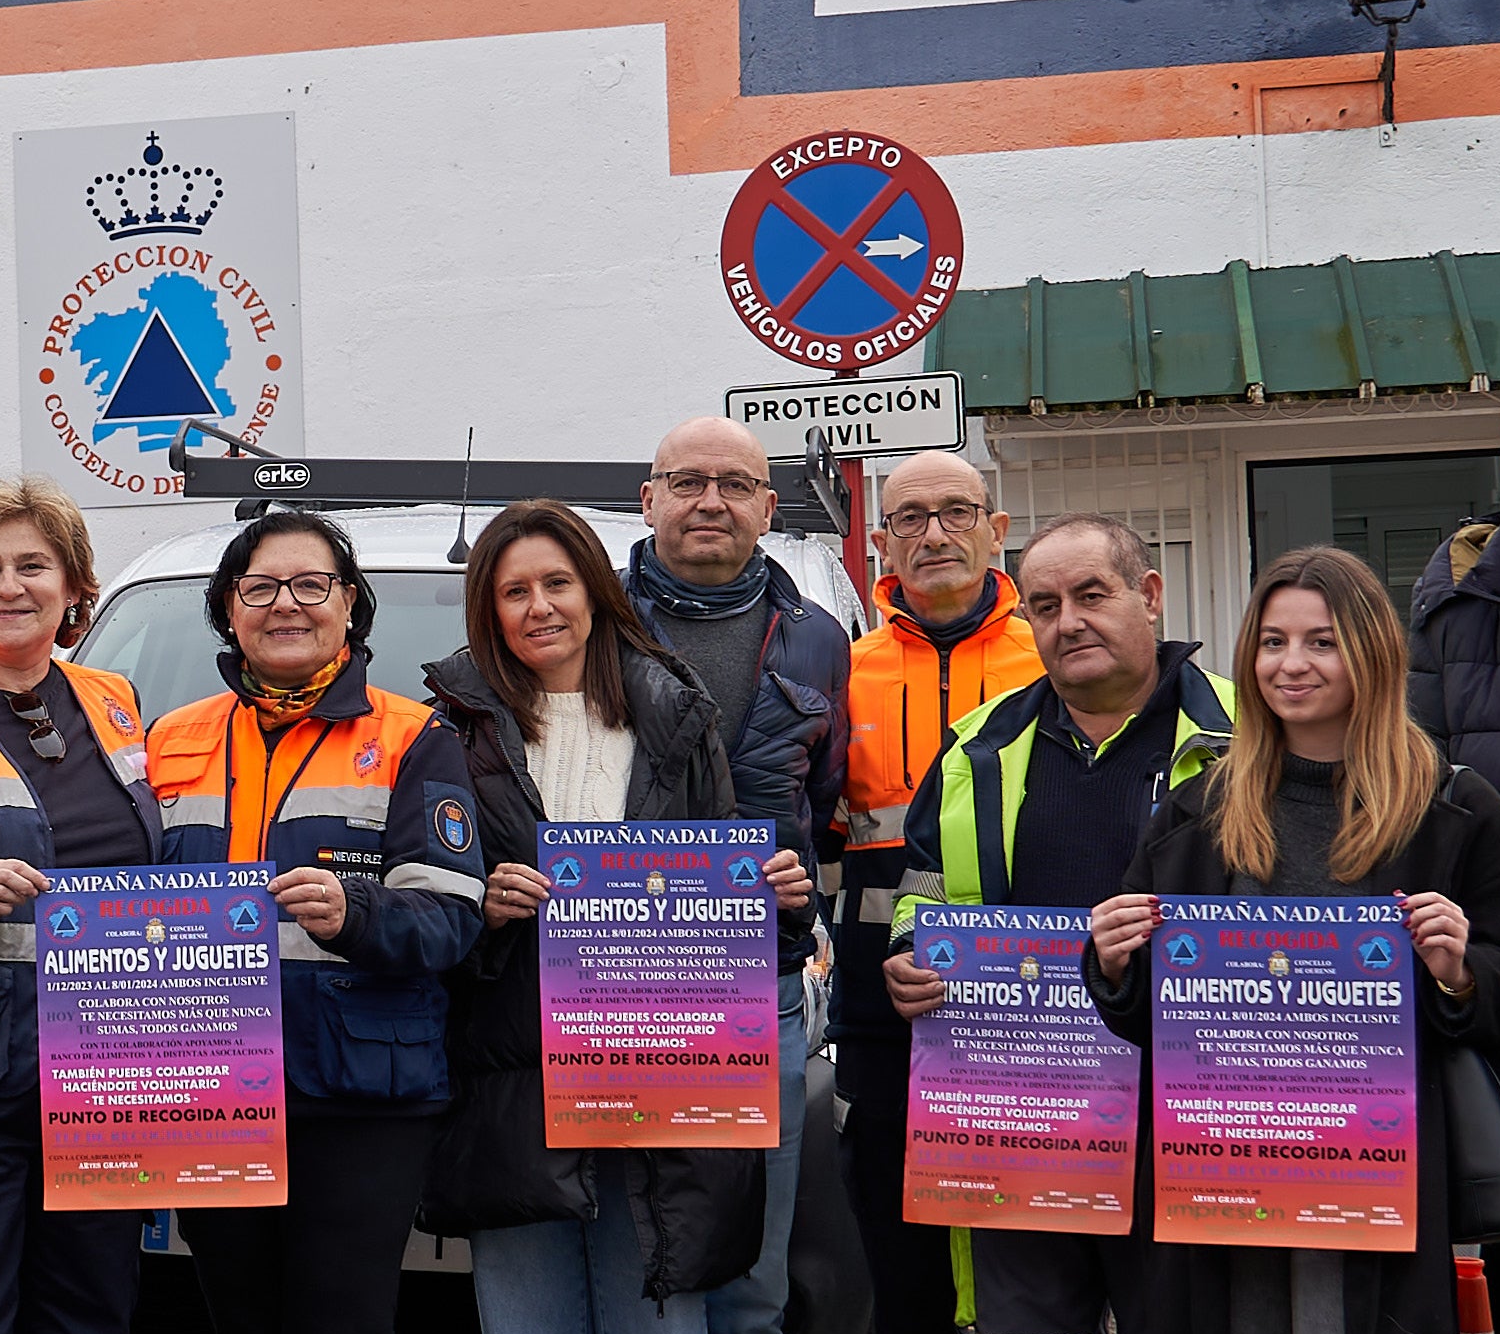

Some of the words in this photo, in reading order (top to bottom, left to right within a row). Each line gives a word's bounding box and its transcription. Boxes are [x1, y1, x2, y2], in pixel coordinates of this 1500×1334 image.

[771, 137, 902, 180] EXCEPTO
[42, 245, 213, 356] PROTECCION
[218, 267, 275, 343] CIVIL
[727, 263, 842, 364] VEHÍCULOS
[854, 255, 956, 361] OFICIALES
[743, 385, 941, 423] PROTECCIÓN
[45, 394, 145, 493] CONCELLO
[154, 476, 185, 495] DE
[257, 464, 307, 483] erke
[543, 825, 646, 844] CAMPAÑA
[651, 828, 723, 844] NADAL
[728, 827, 768, 844] 2023
[333, 851, 361, 863] NIEVES
[363, 853, 382, 865] GLEZ
[600, 852, 711, 869] RECOGIDA
[44, 871, 144, 893] CAMPAÑA
[149, 871, 222, 890] NADAL
[227, 869, 269, 887] 2023
[99, 897, 211, 917] RECOGIDA
[546, 898, 649, 921] ALIMENTOS
[654, 898, 667, 921] Y
[672, 898, 766, 921] JUGUETES
[1158, 901, 1267, 921] CAMPAÑA
[1272, 905, 1351, 922] NADAL
[1357, 905, 1402, 923] 2023
[920, 909, 1022, 929] CAMPAÑA
[976, 936, 1083, 956] RECOGIDA
[1218, 929, 1339, 949] RECOGIDA
[44, 947, 149, 974] ALIMENTOS
[154, 946, 168, 971] Y
[172, 944, 268, 971] JUGUETES
[47, 980, 92, 991] 1/12/2023
[93, 980, 110, 990] AL
[111, 979, 157, 989] 8/01/2024
[159, 977, 201, 988] AMBOS
[204, 975, 267, 987] INCLUSIVE
[1160, 977, 1272, 1004] ALIMENTOS
[1277, 979, 1292, 1004] Y
[1297, 980, 1401, 1006] JUGUETES
[78, 997, 140, 1008] COLABORA
[142, 996, 167, 1007] CON
[168, 994, 229, 1006] NOSOTROS
[943, 978, 1022, 1006] IMENTOS
[1026, 983, 1040, 1007] Y
[1044, 984, 1094, 1010] JUGU
[80, 1011, 94, 1021] TE
[97, 1009, 176, 1021] NECESITAMOS
[178, 1007, 203, 1019] MÁS
[204, 1008, 228, 1020] QUE
[231, 1007, 271, 1017] NUNCA
[97, 1024, 138, 1035] SUMAS,
[141, 1023, 178, 1033] TODOS
[180, 1021, 237, 1032] GANAMOS
[52, 1066, 105, 1079] TAMBIÉN
[108, 1067, 152, 1078] PUEDES
[155, 1065, 230, 1077] COLABORAR
[62, 1079, 137, 1092] HACIÉNDOTE
[140, 1078, 220, 1090] VOLUNTARIO
[92, 1095, 105, 1105] TE
[108, 1093, 190, 1105] NECESITAMOS
[50, 1111, 106, 1124] PUNTO
[113, 1110, 133, 1123] DE
[139, 1108, 226, 1123] RECOGIDA
[232, 1106, 275, 1120] AQUI
[151, 1225, 162, 1240] E
